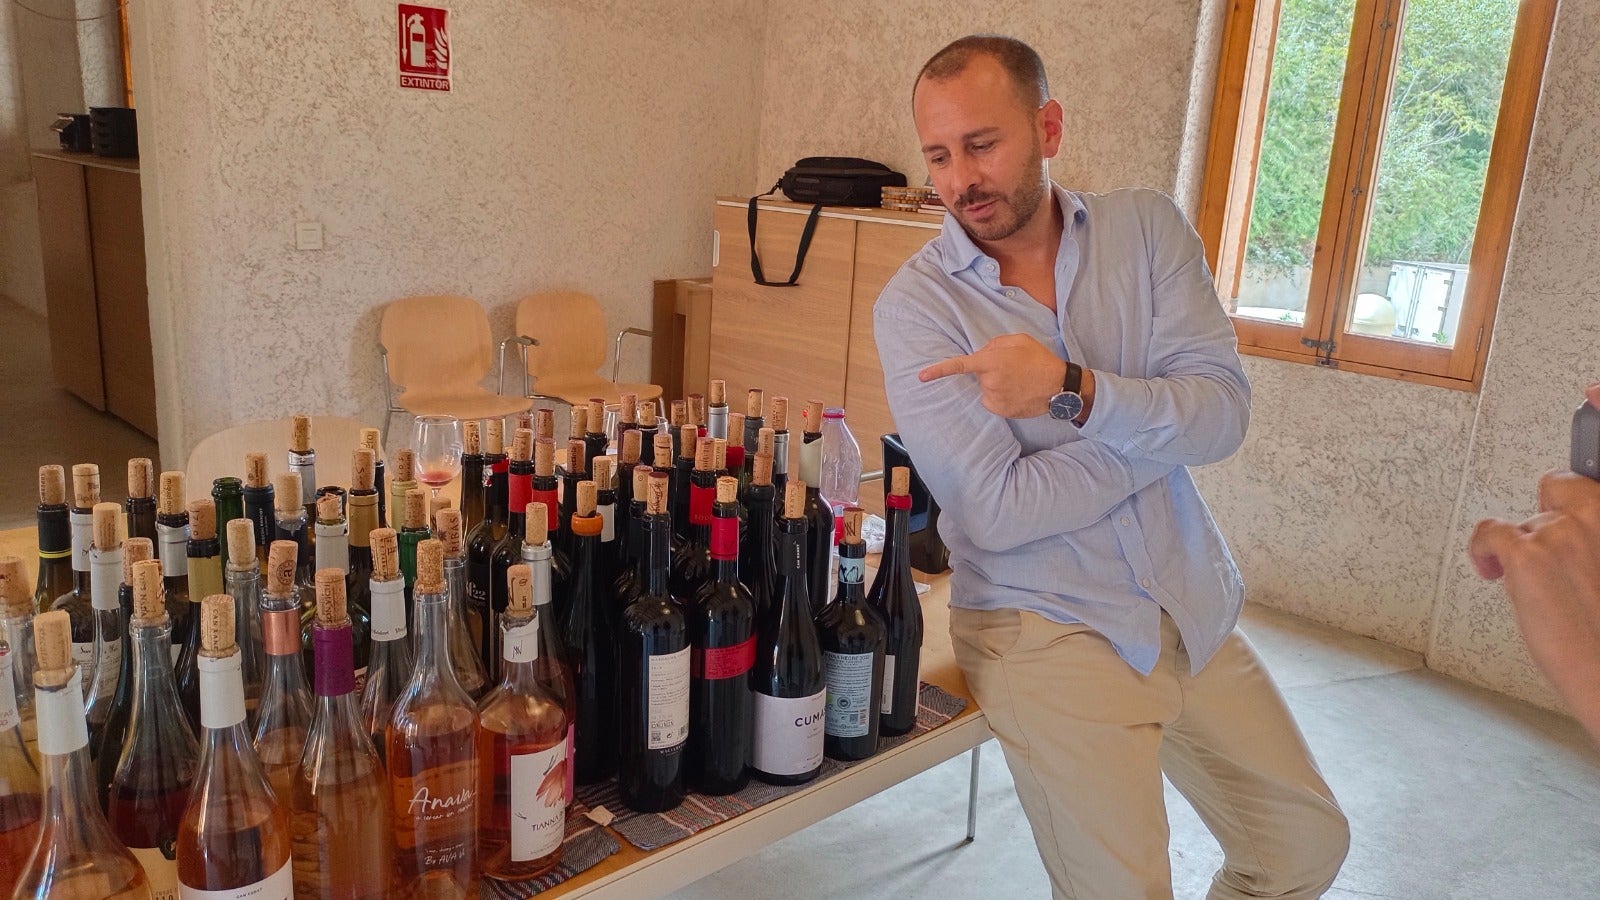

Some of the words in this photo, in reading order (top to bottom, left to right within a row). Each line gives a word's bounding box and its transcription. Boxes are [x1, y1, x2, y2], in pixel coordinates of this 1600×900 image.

[402, 77, 448, 90] EXTINTOR
[450, 517, 459, 552] RIBAS
[408, 786, 473, 814] Anava
